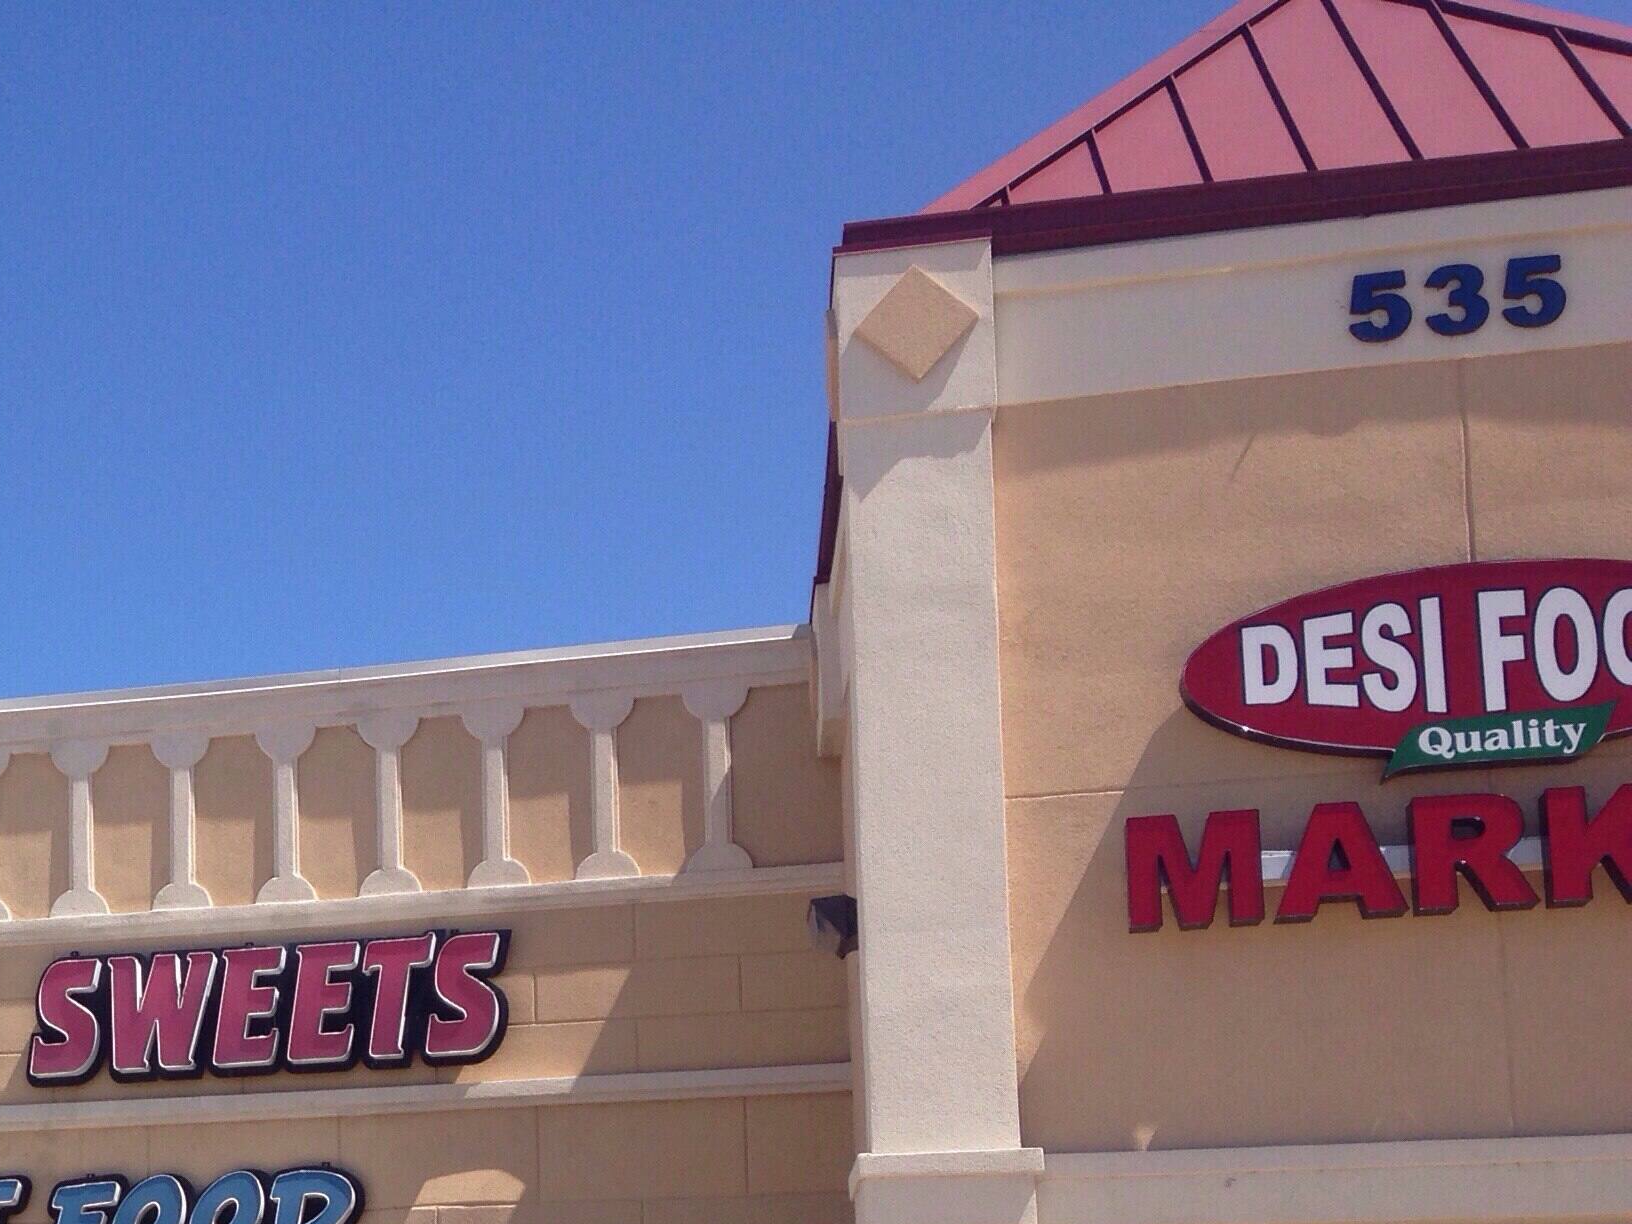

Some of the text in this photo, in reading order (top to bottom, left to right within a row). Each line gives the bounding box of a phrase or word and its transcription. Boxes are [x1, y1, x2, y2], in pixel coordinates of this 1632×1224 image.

[1348, 253, 1568, 344] 535
[1239, 594, 1450, 714] DESI
[1416, 716, 1588, 759] Quality
[1125, 782, 1632, 934] MARK
[28, 929, 511, 1087] SWEETS
